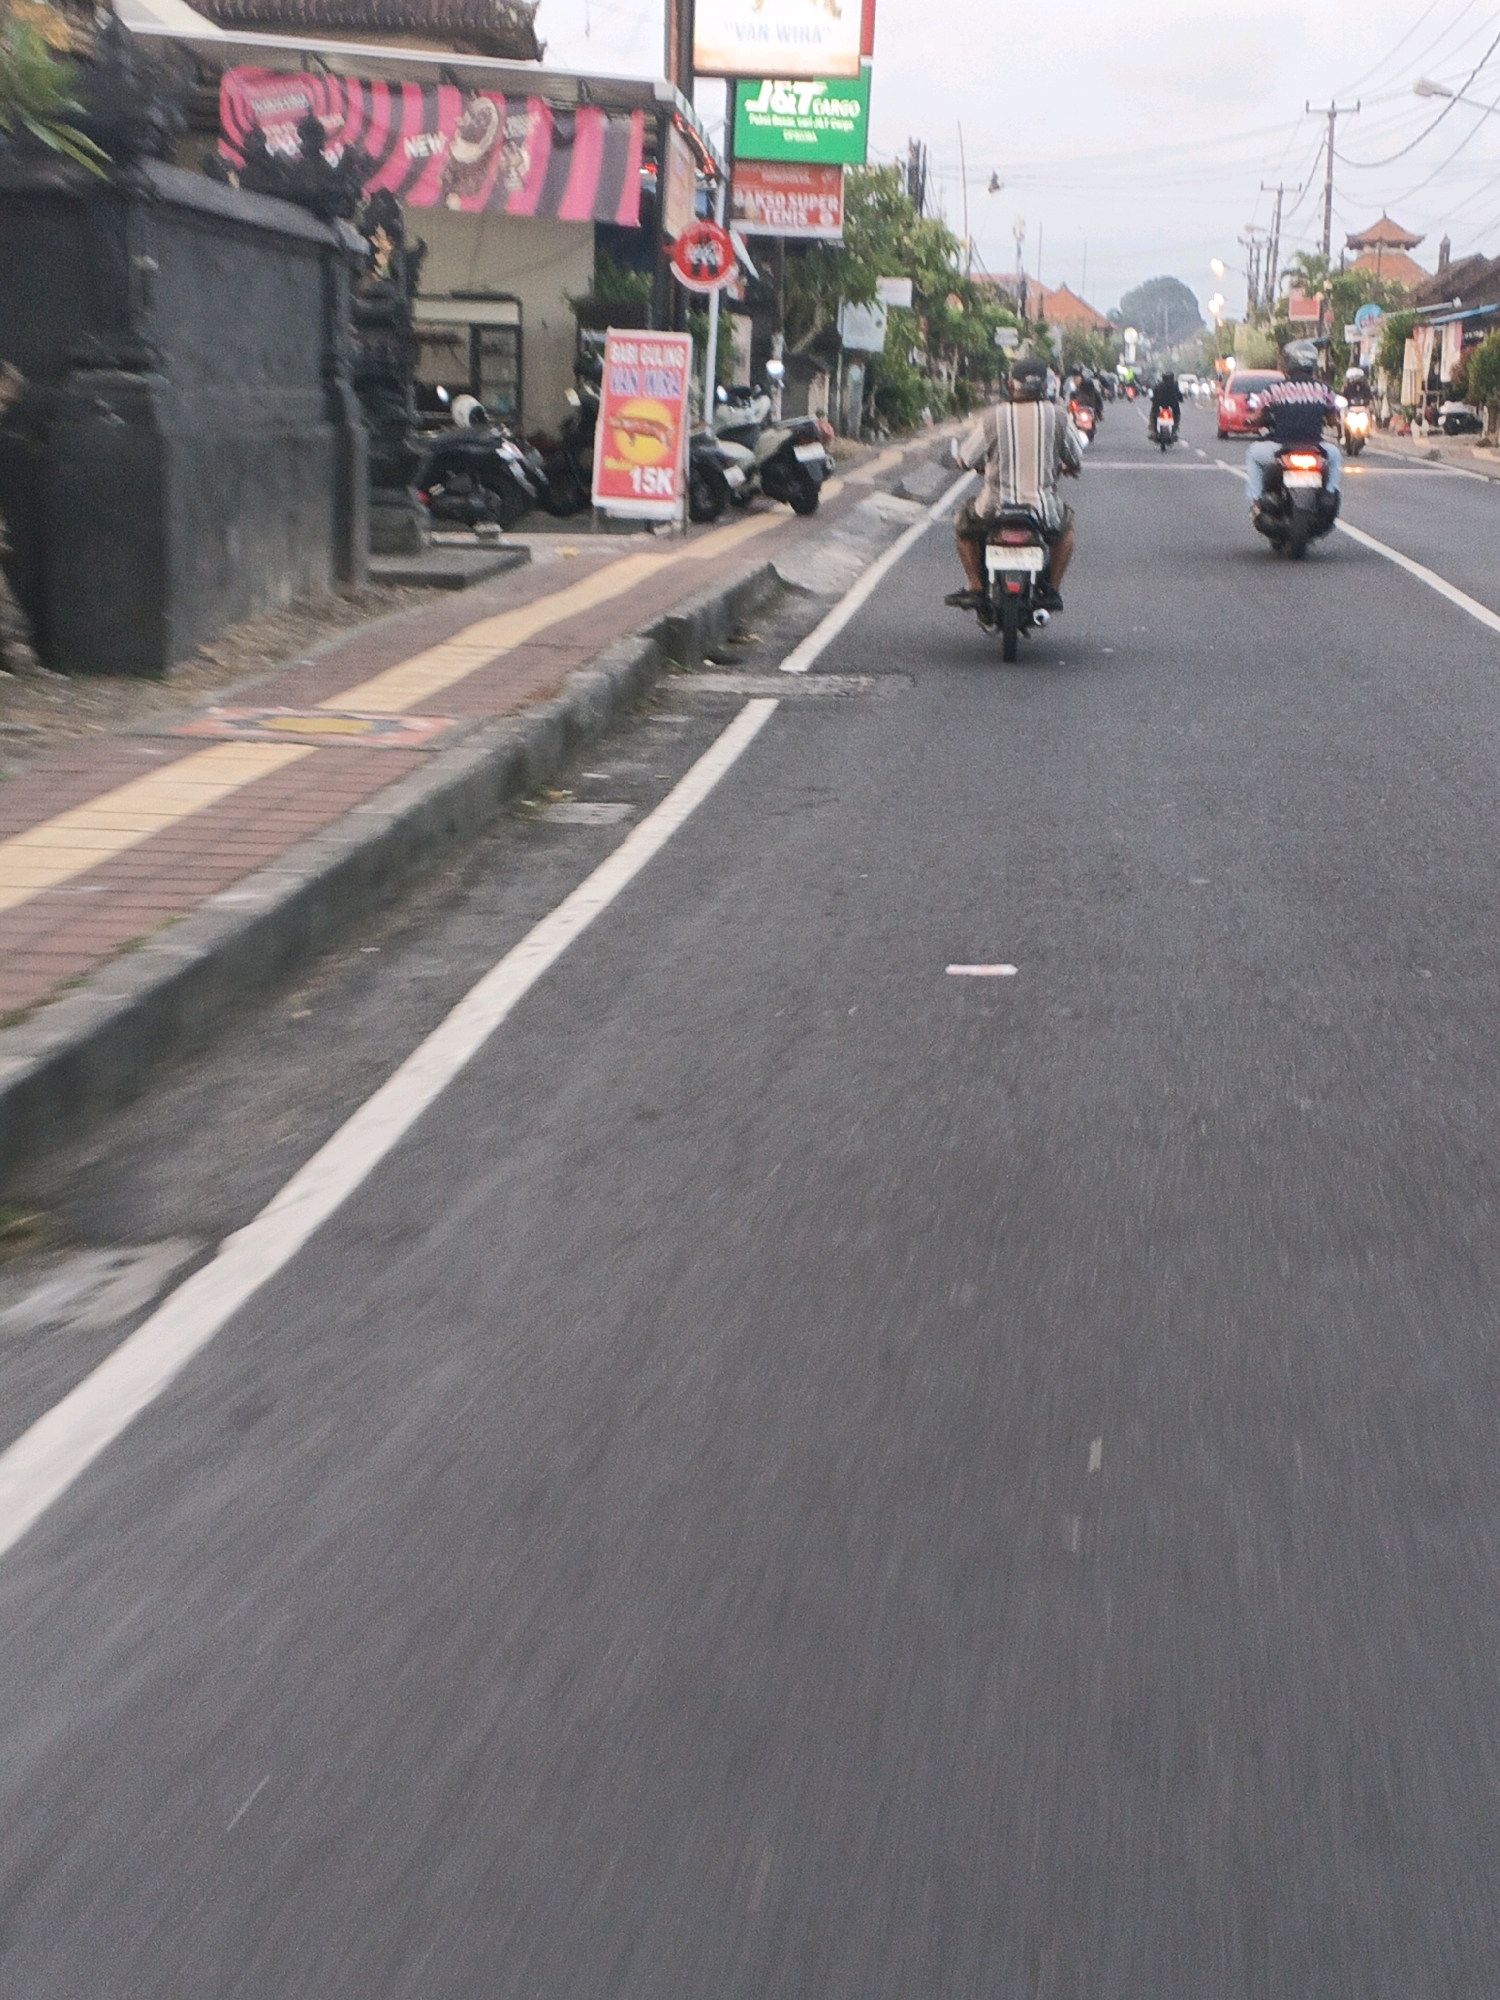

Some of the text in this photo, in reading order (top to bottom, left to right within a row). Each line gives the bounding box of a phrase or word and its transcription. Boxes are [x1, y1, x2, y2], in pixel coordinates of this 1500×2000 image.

[744, 79, 861, 118] J&T CARGO
[403, 132, 447, 159] NEW
[786, 191, 839, 212] SUPER
[629, 465, 675, 495] 15K
